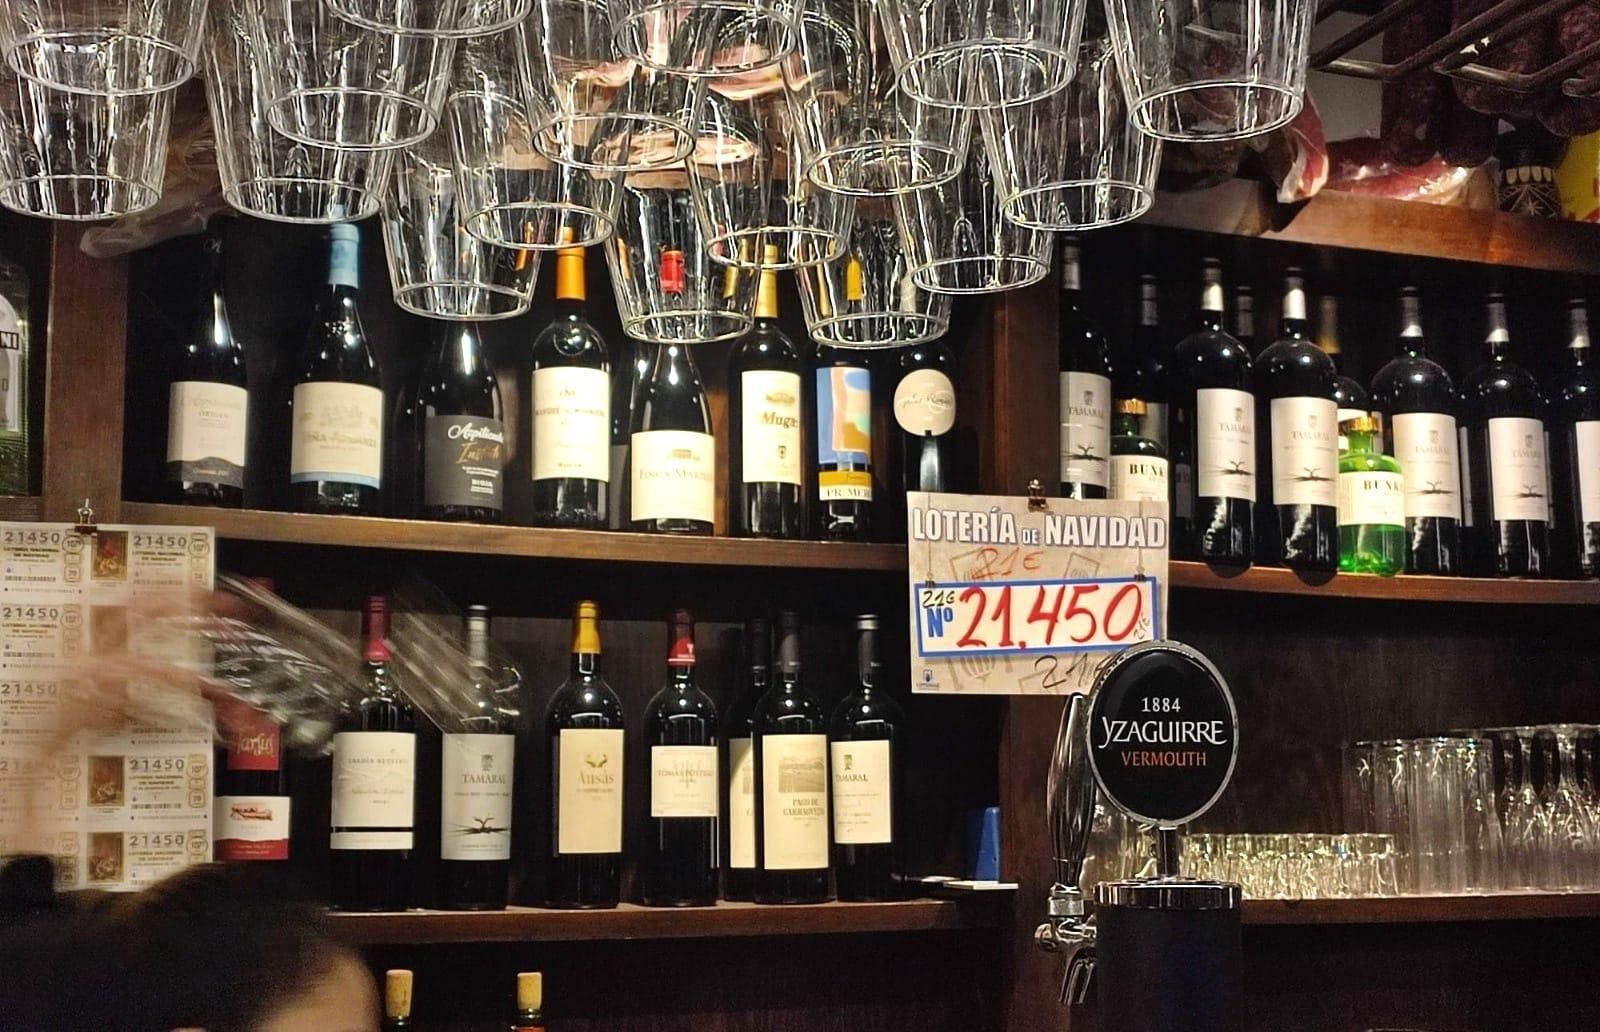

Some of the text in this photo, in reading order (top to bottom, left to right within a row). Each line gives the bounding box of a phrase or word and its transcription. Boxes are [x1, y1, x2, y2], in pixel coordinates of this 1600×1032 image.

[912, 505, 1168, 549] LOTERÍA DE NAVIDAD
[4, 530, 61, 545] 21450
[132, 535, 188, 548] 21450
[2, 606, 60, 620] 21450
[956, 583, 1143, 650] 21.450
[1140, 697, 1182, 713] 1884
[1098, 716, 1228, 749] YZAGUIRRE
[128, 758, 185, 772] 21450
[1120, 751, 1207, 767] VERMOUTH
[128, 834, 185, 847] 21450
